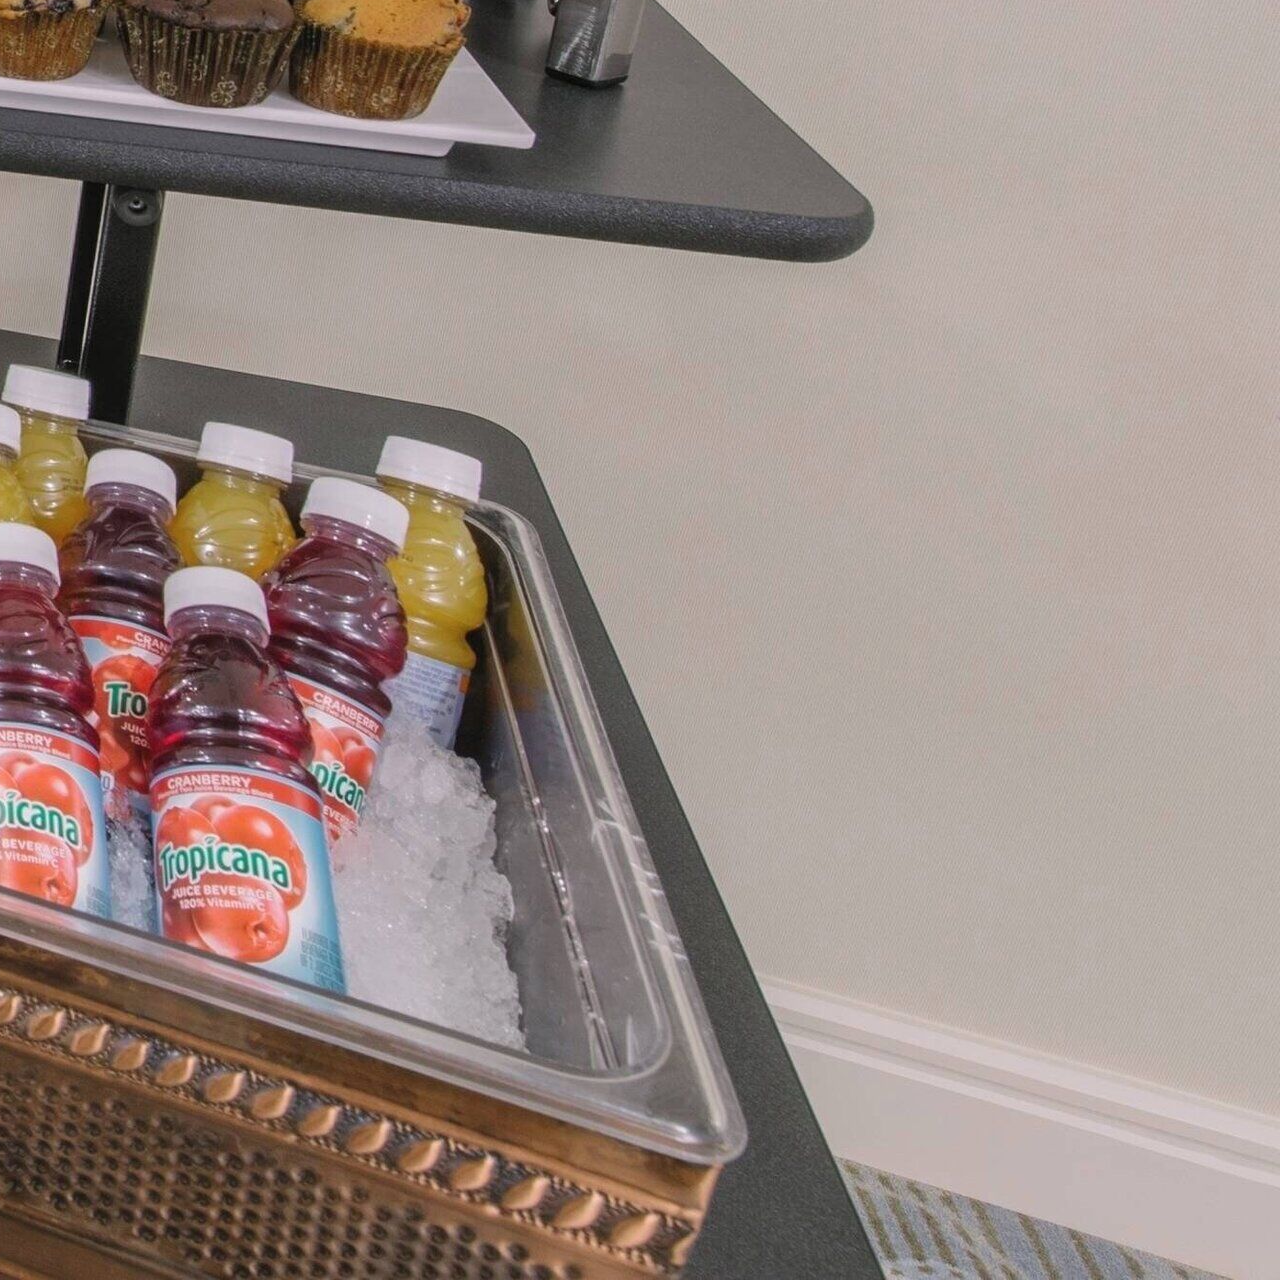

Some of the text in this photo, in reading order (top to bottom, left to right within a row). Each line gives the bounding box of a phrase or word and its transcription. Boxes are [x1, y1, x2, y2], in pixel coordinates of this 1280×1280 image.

[105, 683, 147, 717] Tro
[312, 691, 380, 734] CRANBERRY
[121, 721, 147, 738] JUIC
[167, 774, 252, 790] CRANBERRY
[2, 838, 67, 859] BEVERAGE
[4, 851, 50, 867] Vitamin
[159, 835, 291, 890] Tropicana
[172, 884, 274, 901] JUICE BEVERAGE
[180, 898, 206, 910] 120%
[207, 898, 256, 911] Vitamin
